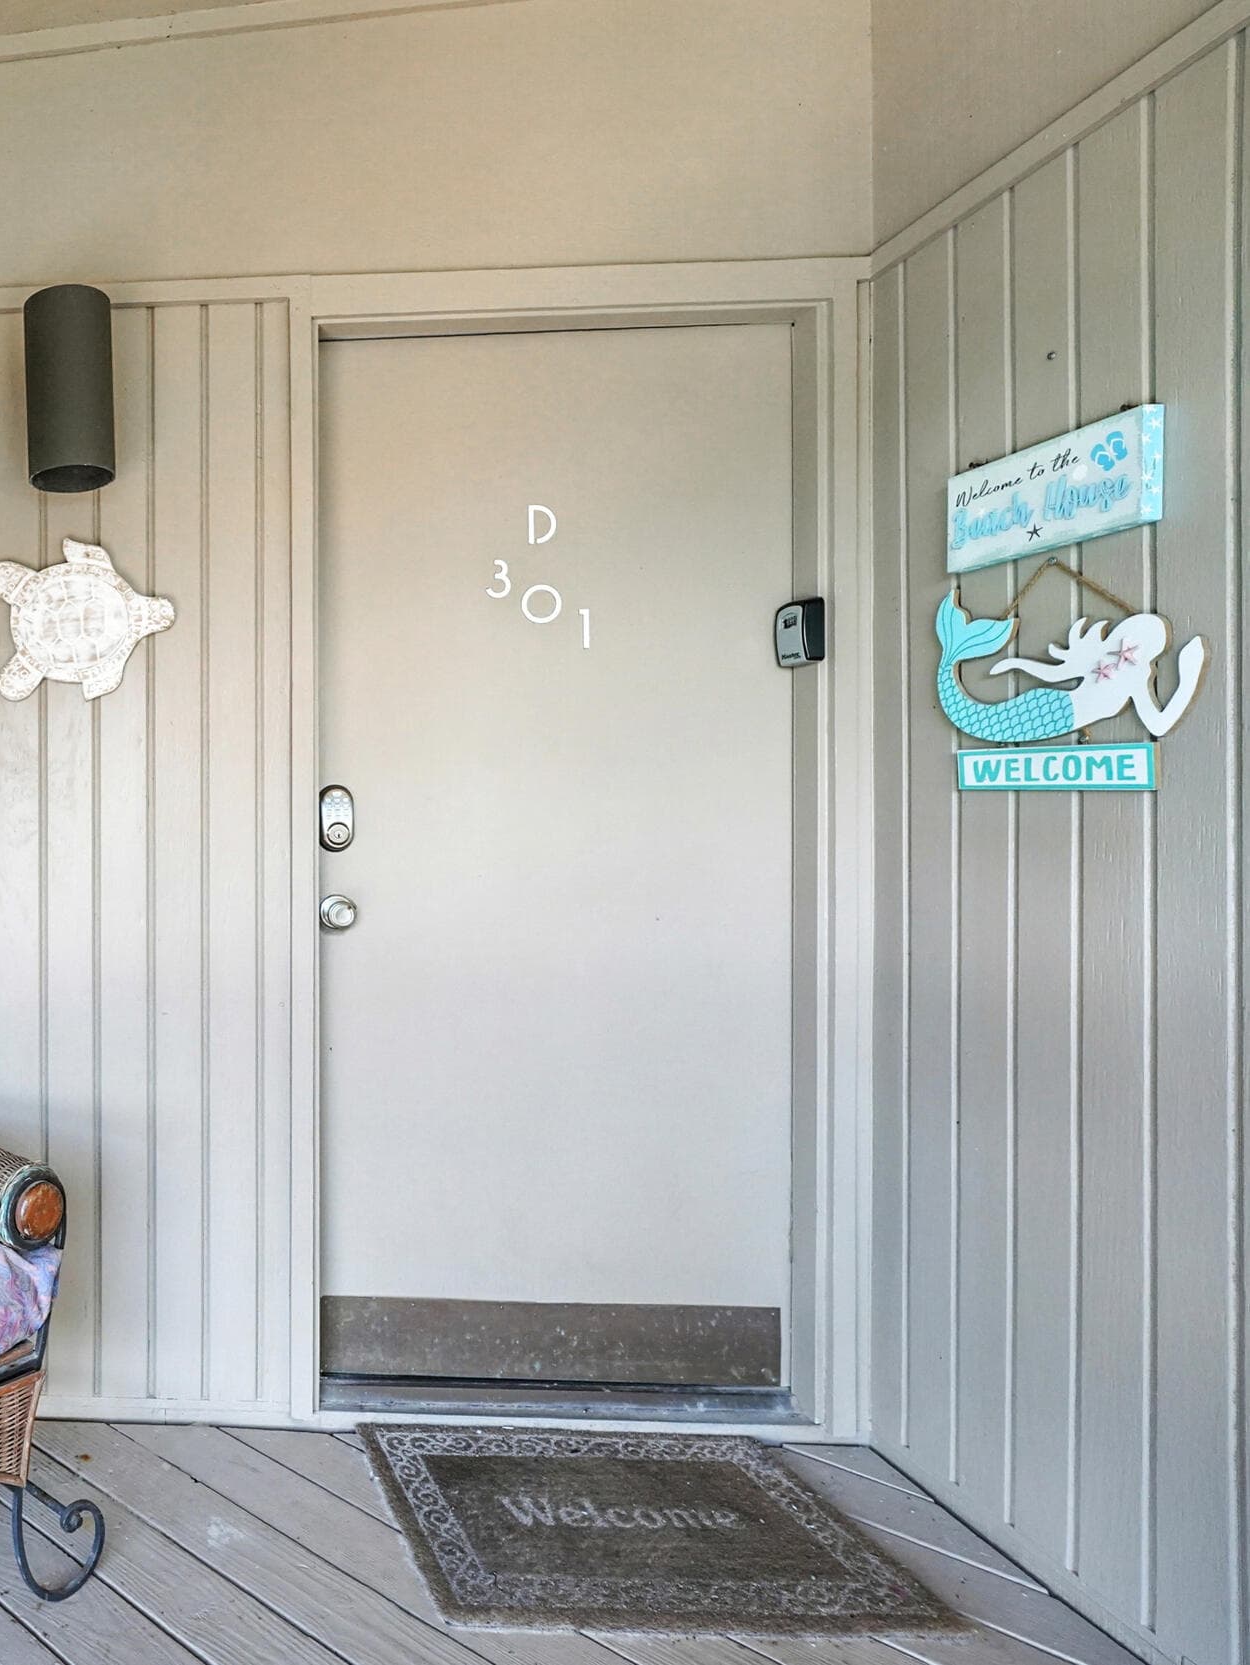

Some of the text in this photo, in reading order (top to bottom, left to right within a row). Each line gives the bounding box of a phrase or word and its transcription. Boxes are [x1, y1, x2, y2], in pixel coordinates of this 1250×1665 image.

[955, 447, 1082, 508] Welcome to the
[527, 504, 557, 545] D
[951, 474, 1132, 550] Beach House
[972, 753, 1138, 783] WELCOME
[497, 1493, 741, 1530] Welcome
